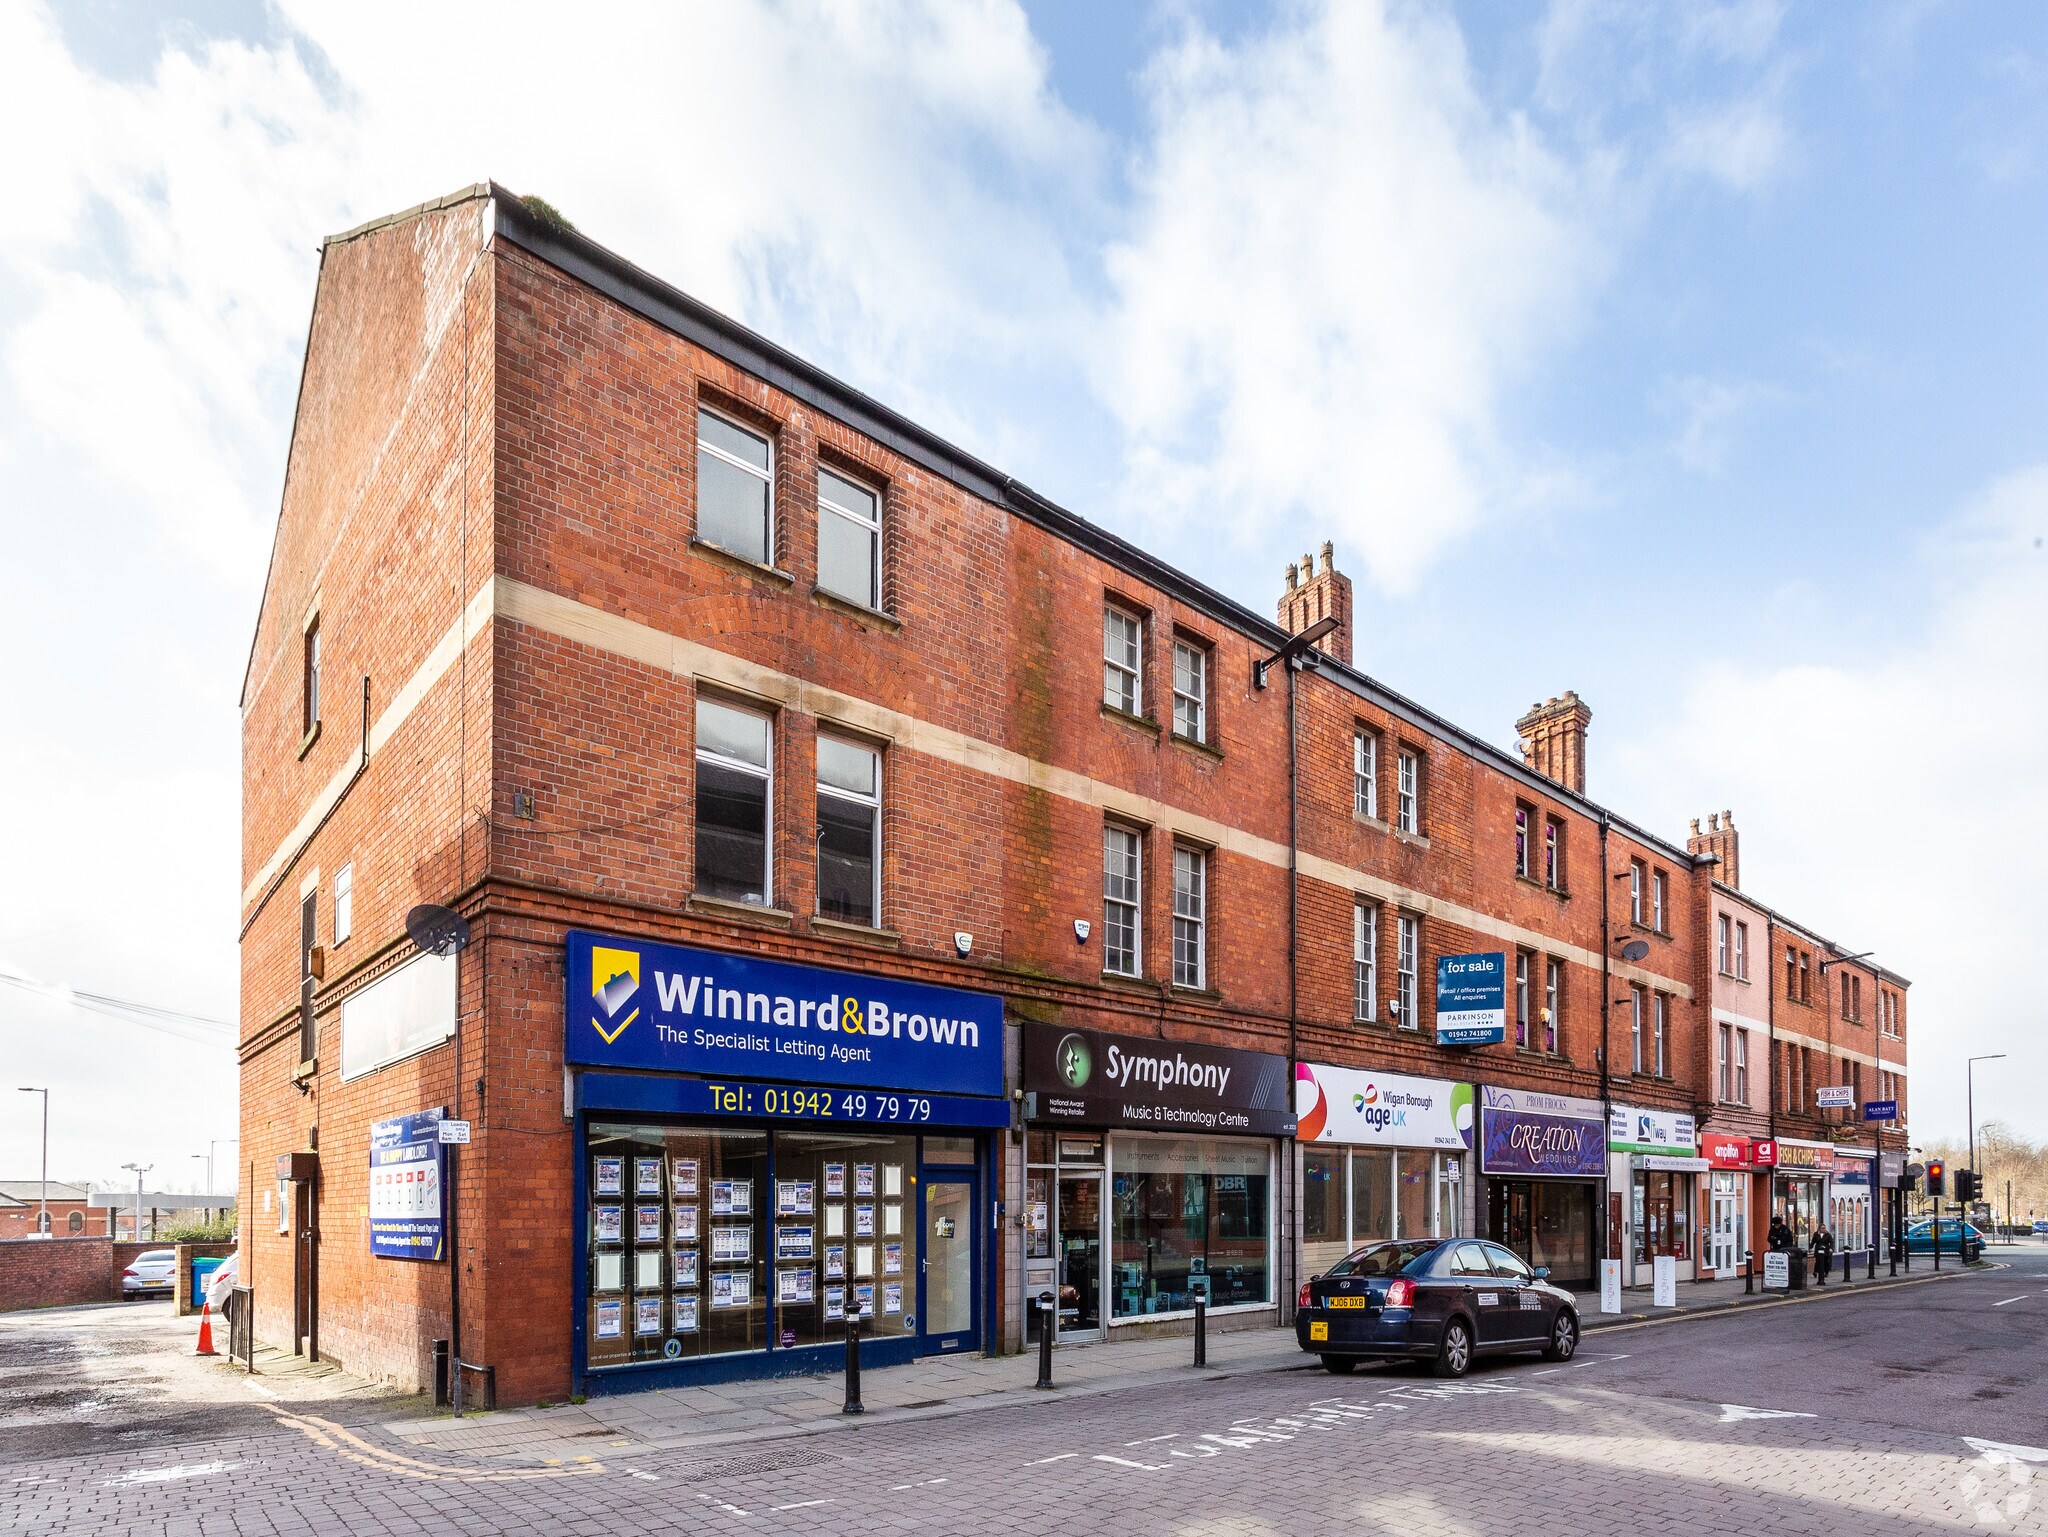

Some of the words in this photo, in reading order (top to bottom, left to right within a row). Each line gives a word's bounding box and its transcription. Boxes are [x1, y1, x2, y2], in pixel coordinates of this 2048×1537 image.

[1448, 962, 1465, 973] for
[1468, 960, 1494, 971] sale
[653, 971, 979, 1047] Winnard&Brown
[1448, 1013, 1494, 1021] PARKINSON
[656, 1025, 688, 1044] The
[694, 1029, 770, 1052] Specialist
[775, 1037, 826, 1062] Letting
[830, 1043, 871, 1062] Agent
[1106, 1045, 1230, 1097] Symphony
[709, 1085, 752, 1112] Tel:
[764, 1089, 833, 1116] 01942
[842, 1094, 867, 1118] 49
[876, 1097, 899, 1120] 79
[908, 1098, 930, 1121] 79
[1382, 1090, 1405, 1107] Wigan
[1406, 1093, 1433, 1110] Borough
[1526, 1095, 1543, 1109] PROM
[1545, 1098, 1567, 1110] FROCKS
[1049, 1107, 1068, 1116] Winning
[1068, 1108, 1085, 1116] Retailer
[1123, 1104, 1152, 1120] Music
[1154, 1107, 1161, 1120] &
[1163, 1106, 1217, 1127] Technology
[1218, 1111, 1249, 1126] Centre
[1510, 1124, 1585, 1160] CREATION
[1127, 1152, 1159, 1161] Instruments
[1167, 1153, 1199, 1162] Accessories
[1539, 1153, 1577, 1164] WEDDINGS
[1779, 1147, 1792, 1164] FISH
[1792, 1148, 1797, 1164] &
[1798, 1148, 1814, 1165] CHIPS
[1215, 1176, 1244, 1190] DBR
[1607, 1263, 1615, 1310] POMFROCKS
[1330, 1298, 1348, 1306] MJ06
[1350, 1298, 1363, 1306] DXB
